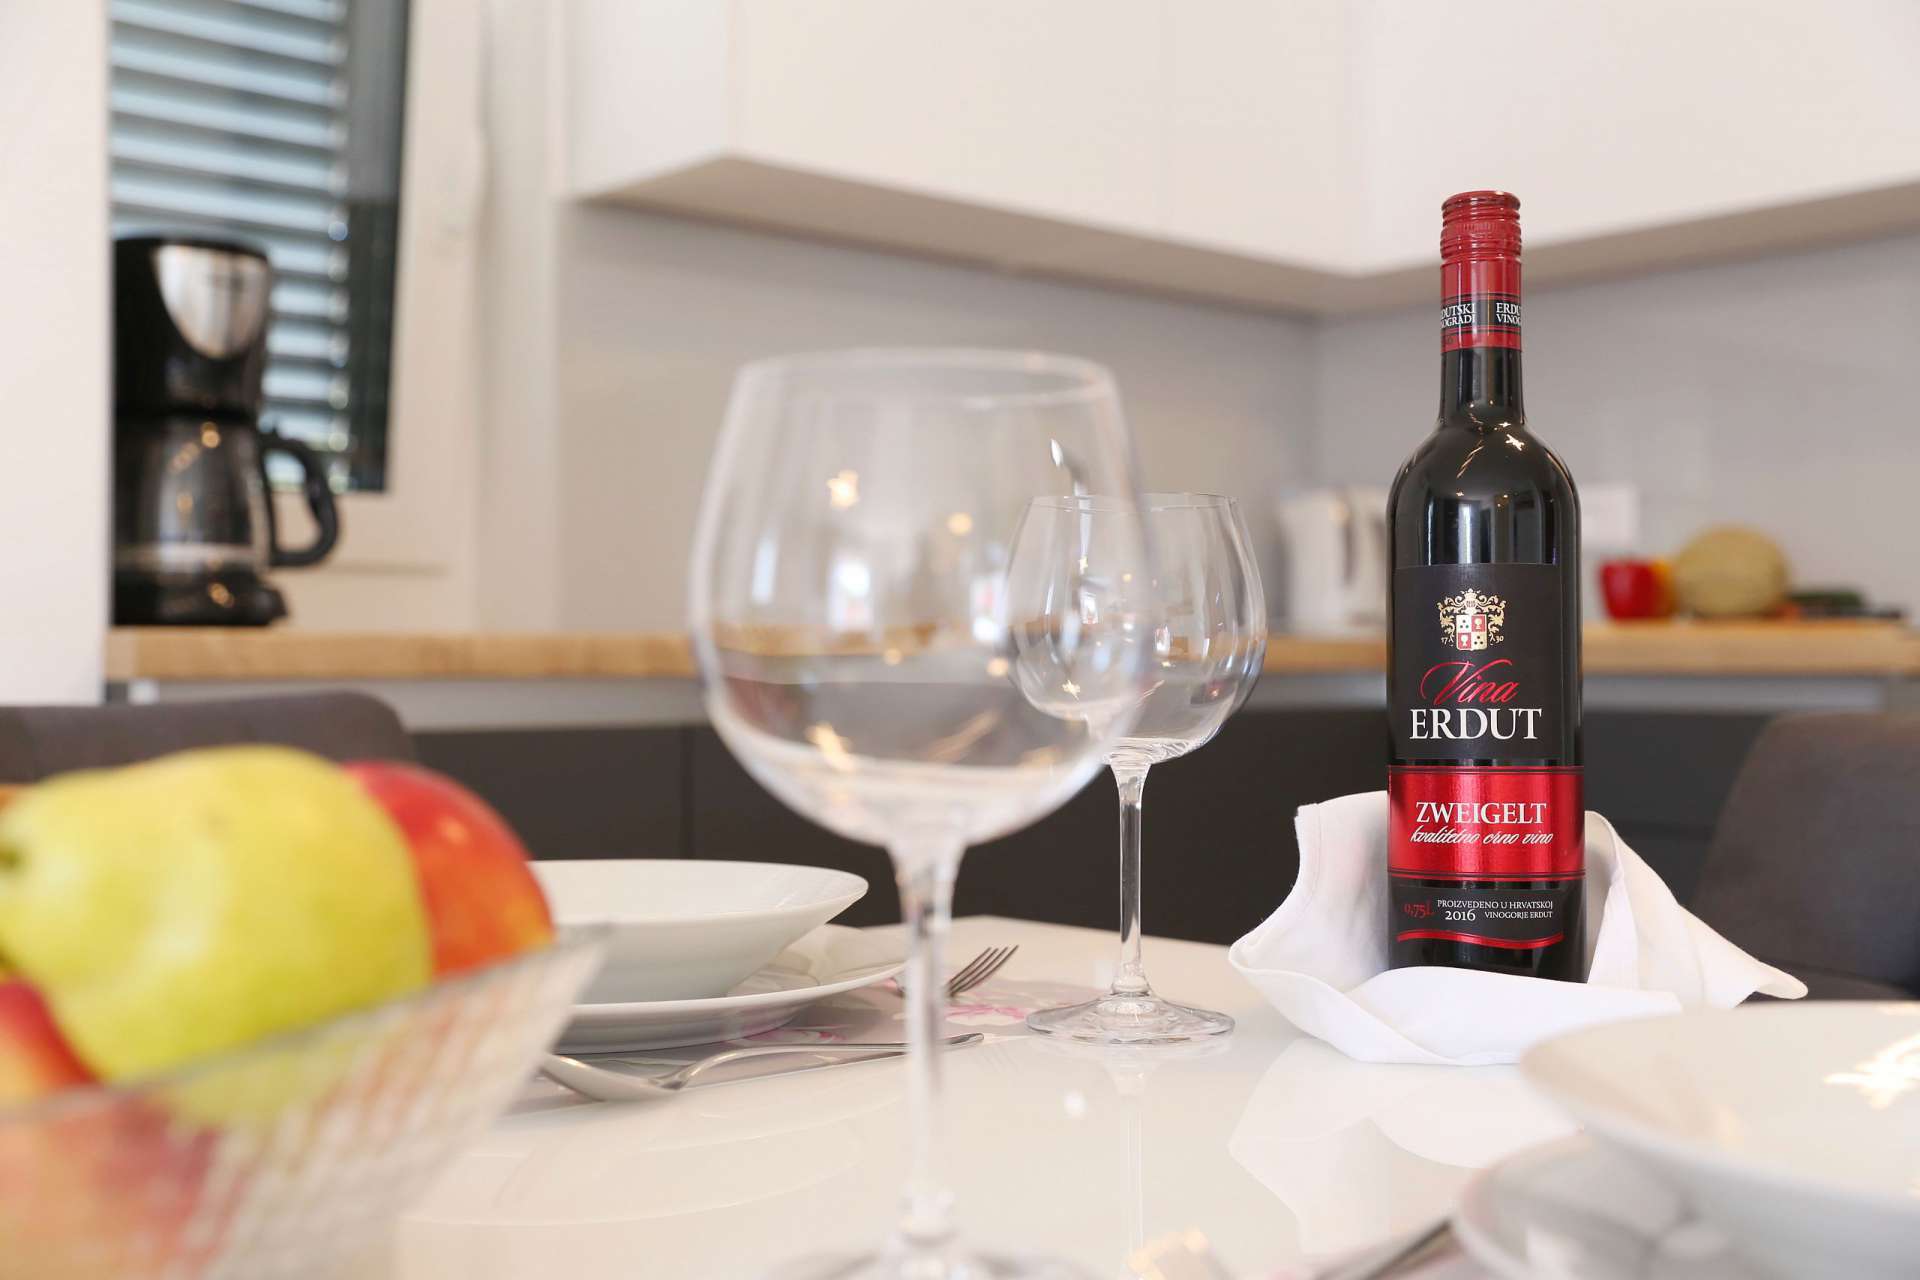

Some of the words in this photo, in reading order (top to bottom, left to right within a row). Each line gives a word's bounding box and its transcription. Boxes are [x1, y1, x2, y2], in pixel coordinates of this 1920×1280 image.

[1420, 658, 1519, 706] Vina
[1409, 708, 1543, 740] ERDUT
[1415, 801, 1547, 824] ZWEIGELT
[1482, 831, 1520, 845] crno
[1522, 830, 1554, 845] vino
[1437, 899, 1499, 909] PROIZVEDENO
[1500, 901, 1508, 909] U
[1509, 900, 1553, 910] HRVATSKOJ
[1445, 909, 1476, 921] 2016
[1484, 911, 1529, 920] VINOGORJE
[1530, 911, 1553, 919] ERDUT
